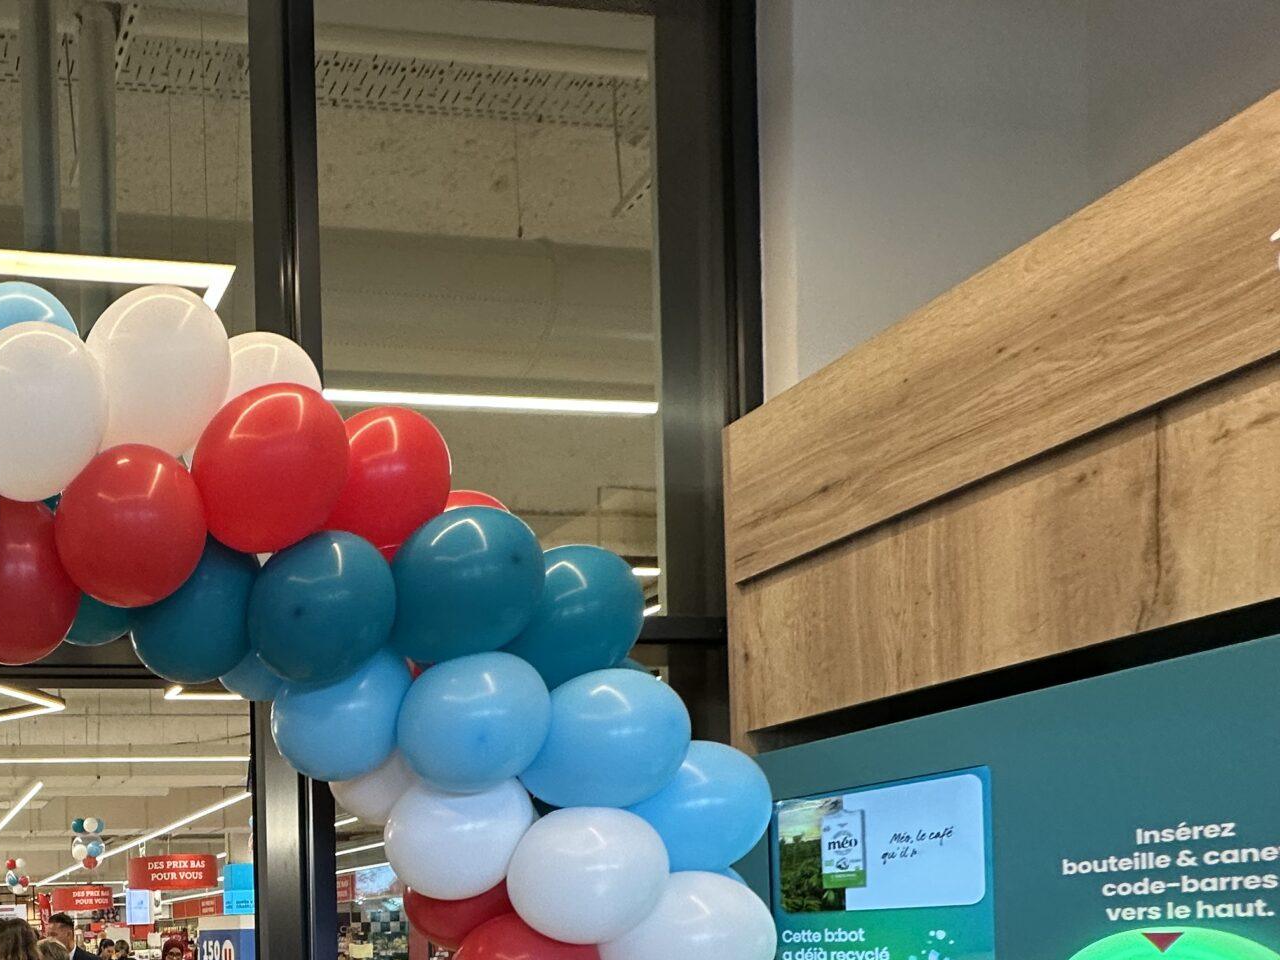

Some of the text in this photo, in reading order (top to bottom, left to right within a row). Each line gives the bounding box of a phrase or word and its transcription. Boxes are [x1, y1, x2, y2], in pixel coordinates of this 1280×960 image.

[827, 836, 858, 851] méo
[916, 829, 926, 842] le
[928, 826, 954, 846] café
[1135, 822, 1236, 845] Insérez
[147, 860, 206, 870] DES PRIX BAS
[1062, 846, 1280, 875] bouteille & cane
[151, 871, 203, 881] POUR VOUS
[1102, 874, 1279, 897] code-barres
[1106, 899, 1275, 921] vers le haut.
[782, 929, 822, 943] Cette
[203, 940, 220, 960] 150
